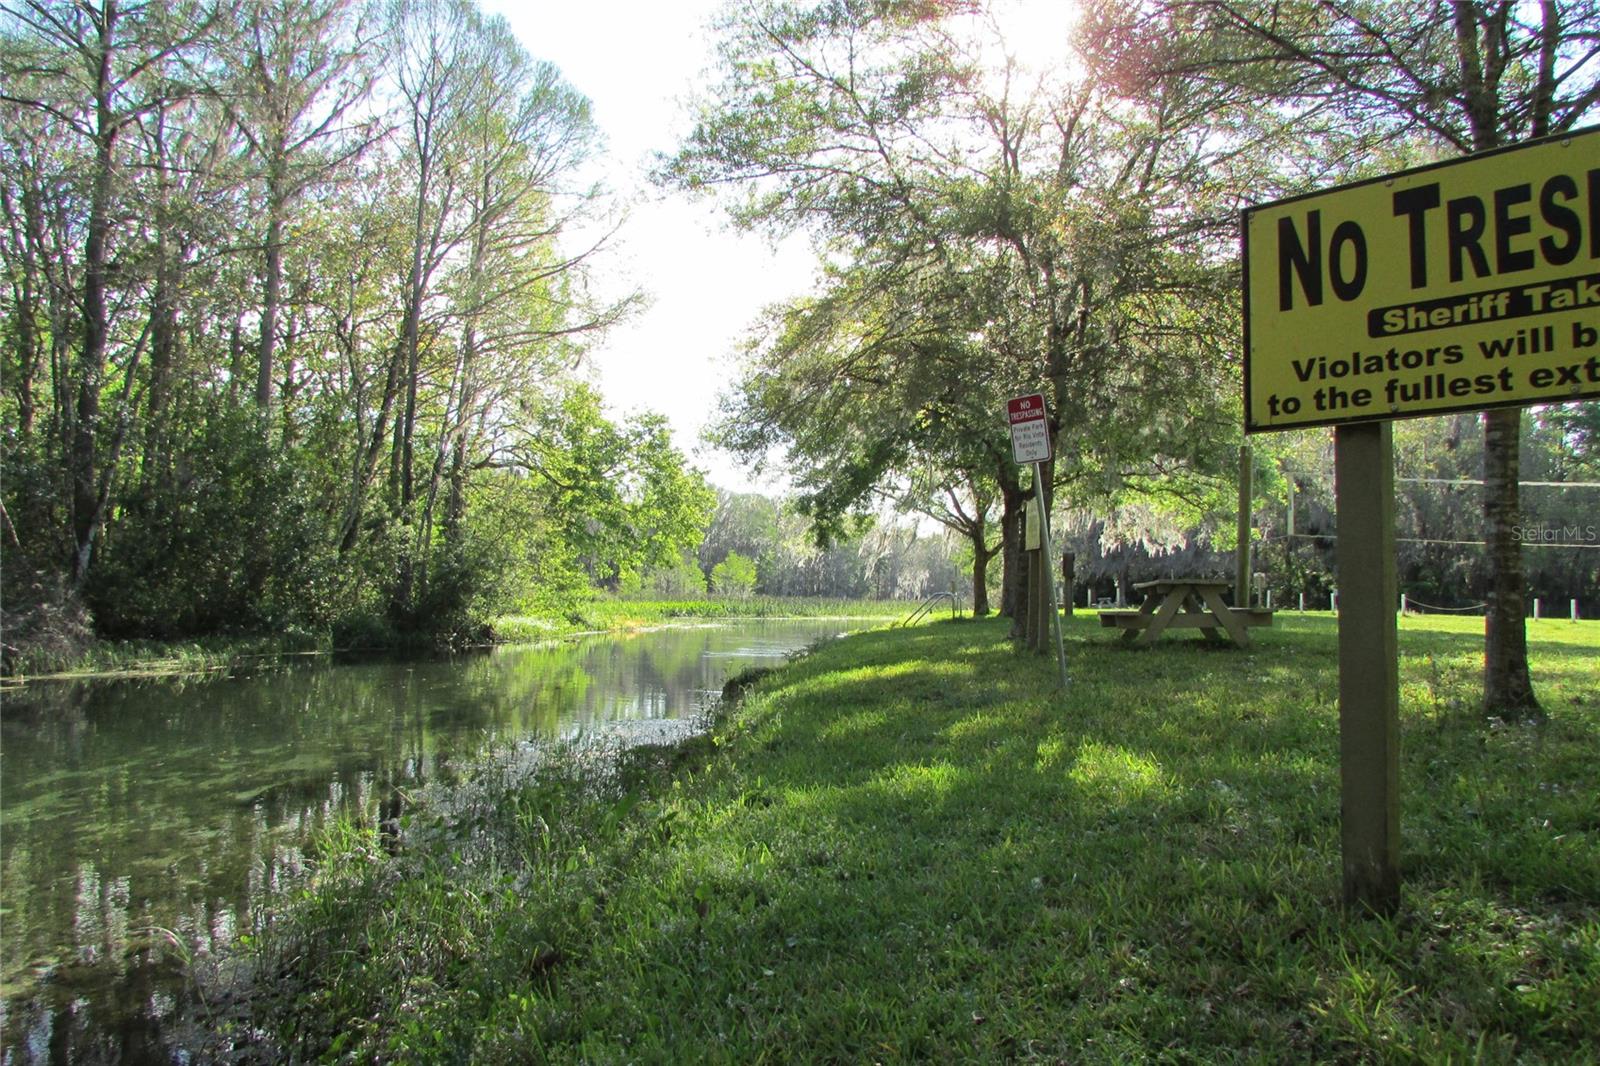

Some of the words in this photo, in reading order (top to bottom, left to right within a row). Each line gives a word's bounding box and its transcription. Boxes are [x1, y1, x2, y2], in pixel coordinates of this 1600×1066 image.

[1277, 209, 1368, 312] NO
[1382, 290, 1511, 334] Sheriff
[1523, 279, 1600, 312] Tak
[1292, 344, 1464, 383] Violators
[1478, 325, 1554, 360] will
[1020, 400, 1031, 410] NO
[1268, 393, 1301, 416] to
[1313, 386, 1371, 412] the
[1384, 368, 1513, 404] fullest
[1529, 355, 1600, 389] ext
[1010, 407, 1043, 421] TRESPASSING
